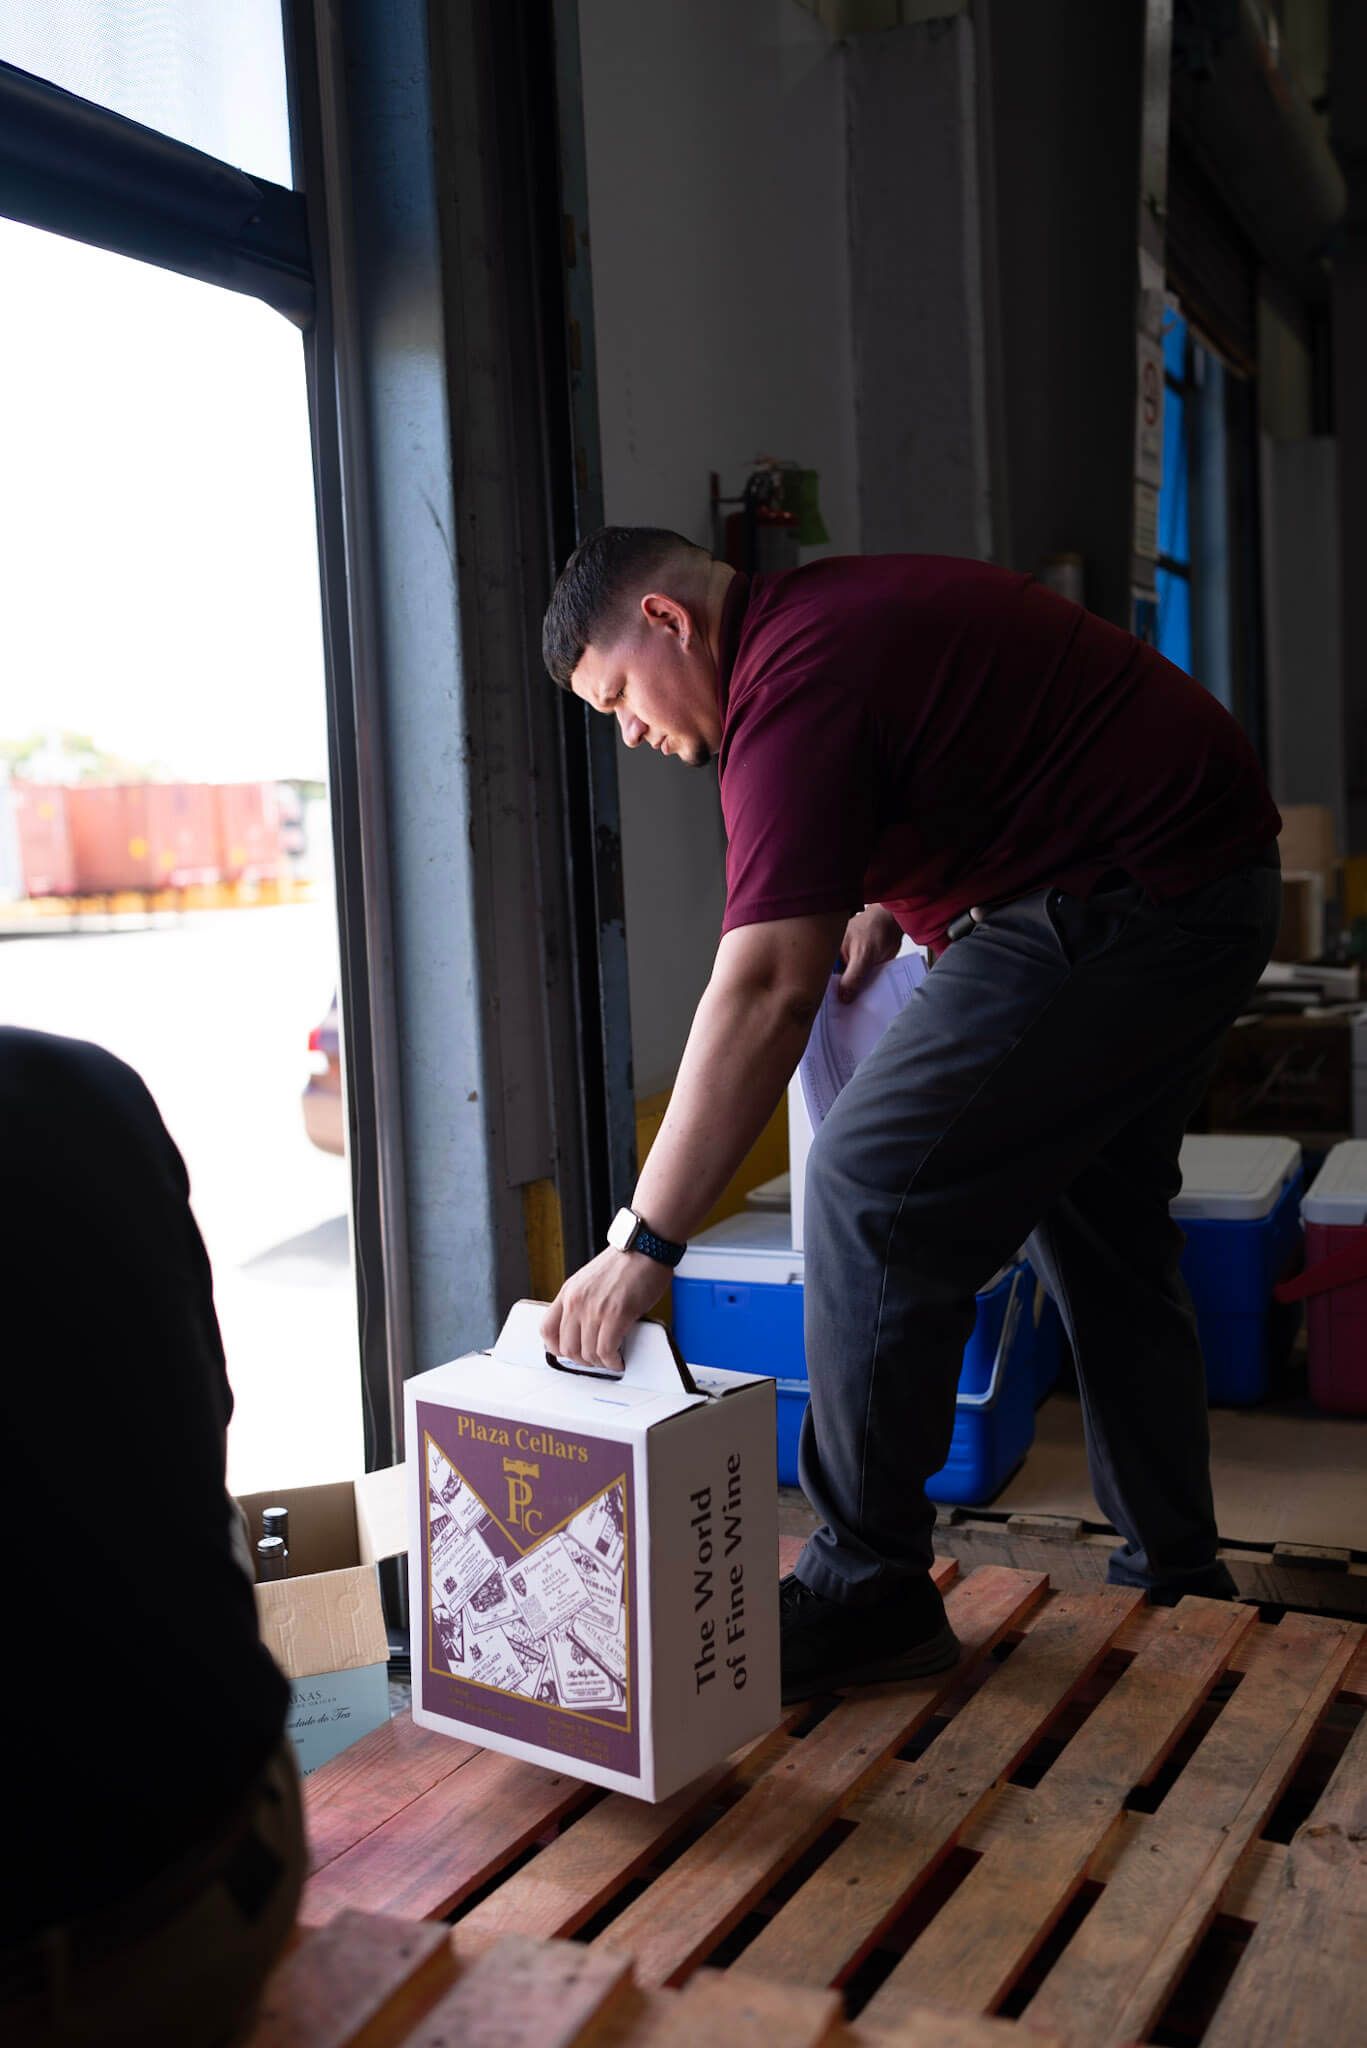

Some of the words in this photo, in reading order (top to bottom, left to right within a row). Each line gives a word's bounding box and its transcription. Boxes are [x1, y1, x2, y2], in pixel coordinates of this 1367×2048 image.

[458, 1415, 510, 1447] Plaza
[515, 1428, 589, 1463] Cellars
[722, 1453, 742, 1557] Wine
[690, 1486, 714, 1613] World
[725, 1564, 745, 1645] Fine
[694, 1618, 716, 1695] The
[726, 1654, 747, 1690] of
